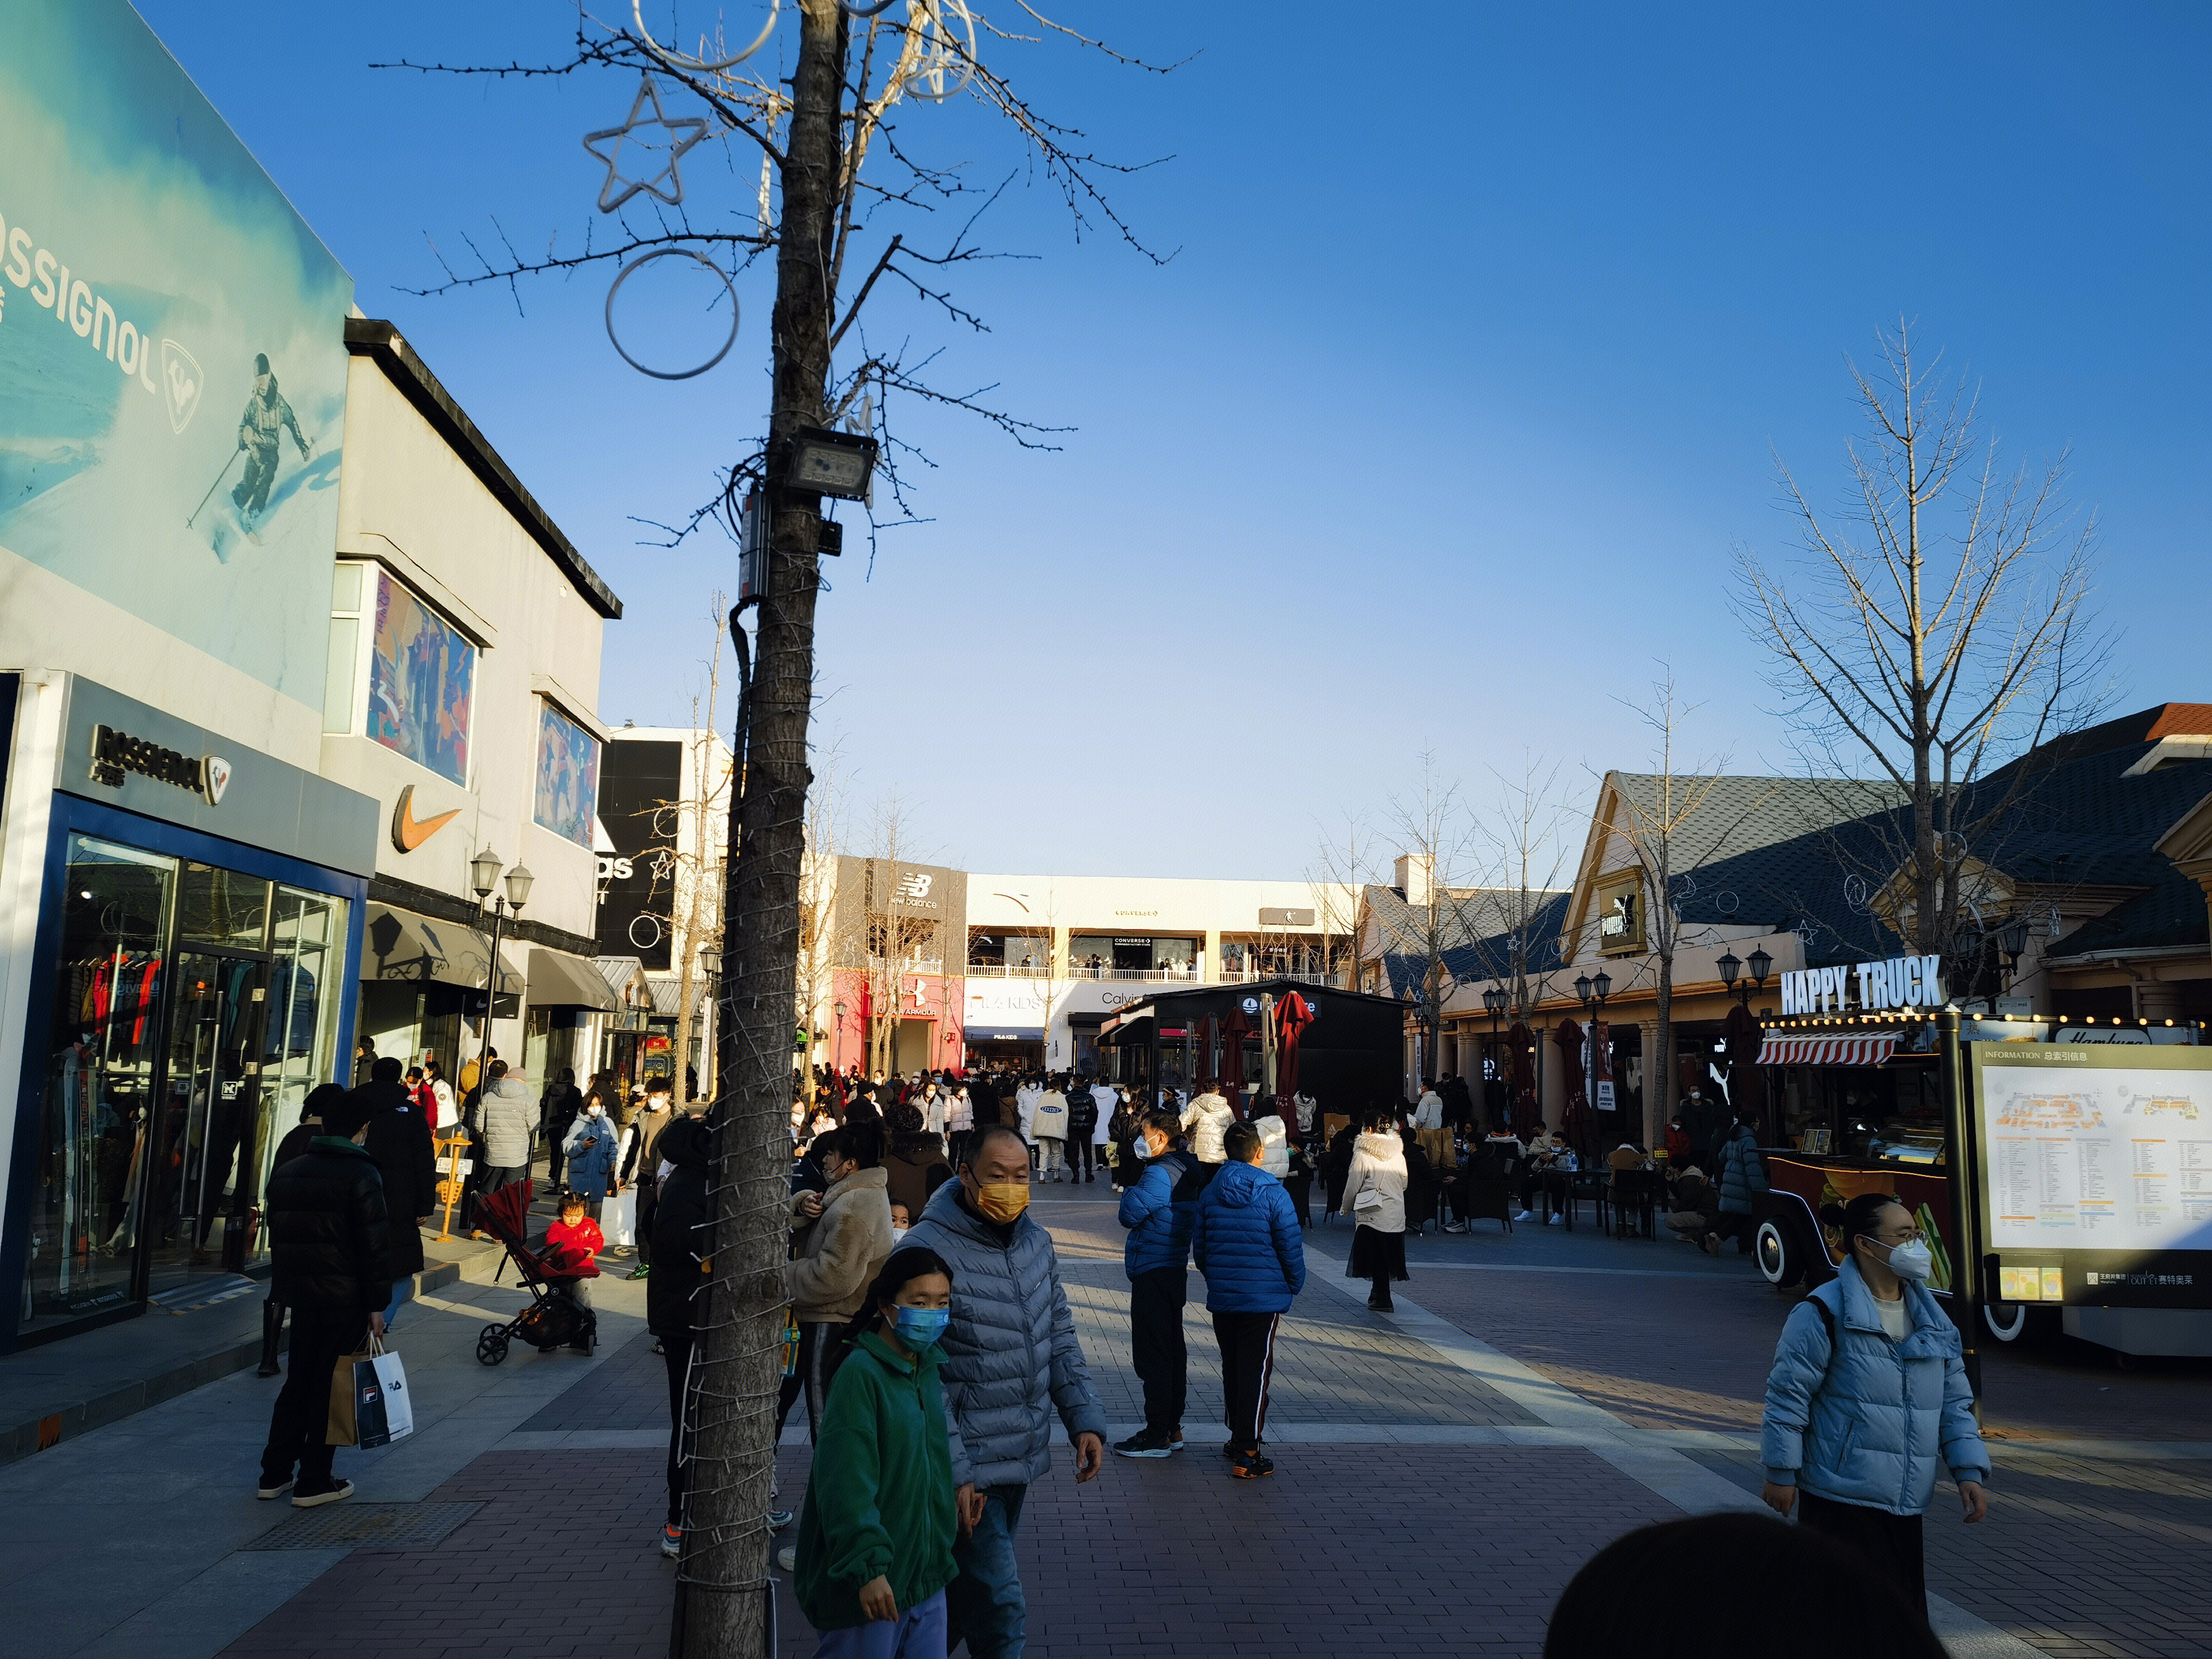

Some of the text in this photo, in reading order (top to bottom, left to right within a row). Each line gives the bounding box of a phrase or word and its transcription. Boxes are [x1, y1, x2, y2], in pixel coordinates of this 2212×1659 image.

[0, 212, 156, 395] SSIGNOL
[1781, 954, 1941, 1015] HAPPY TRUCK
[1985, 1051, 2087, 1062] INFORMATION 总索引信息
[2159, 1275, 2193, 1285] 赛特奥莱
